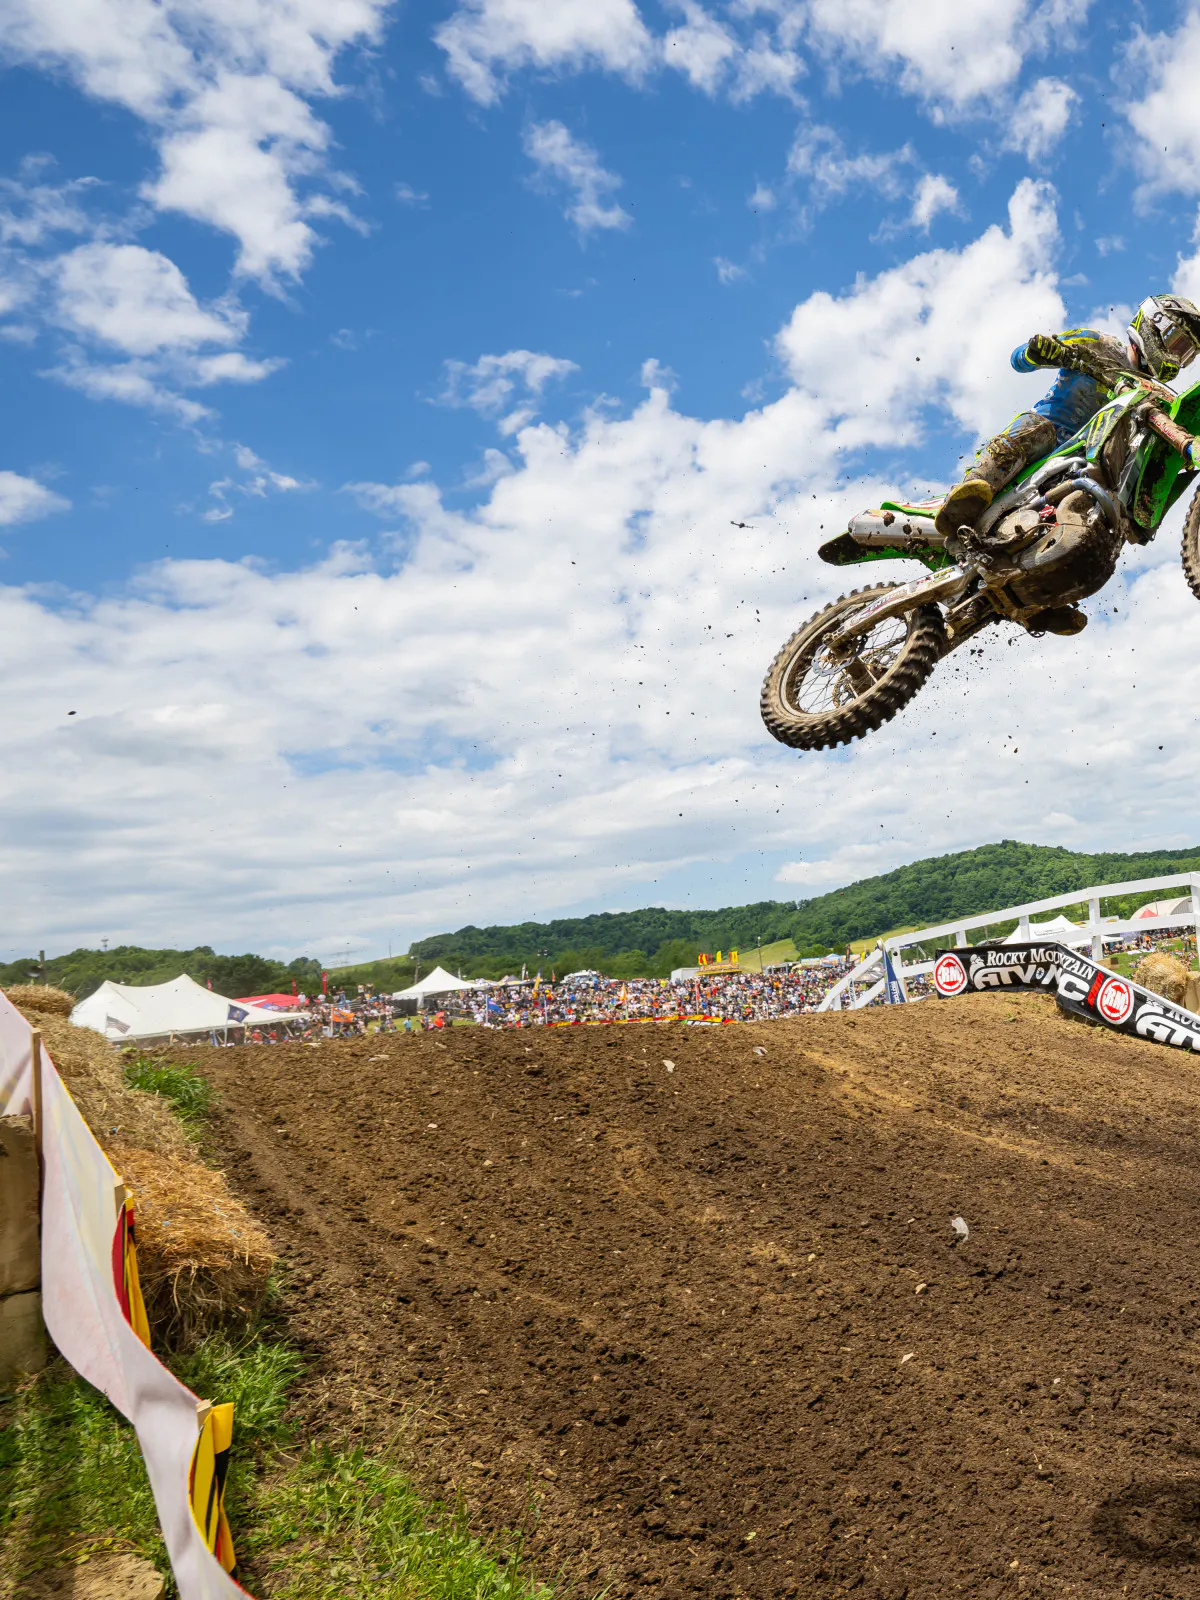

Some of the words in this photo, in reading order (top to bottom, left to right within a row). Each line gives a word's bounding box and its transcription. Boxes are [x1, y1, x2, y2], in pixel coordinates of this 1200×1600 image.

[941, 965, 961, 983] RM
[986, 950, 1028, 966] ROCKY
[1030, 948, 1098, 980] MOUNTAIN
[1104, 990, 1128, 1011] RM
